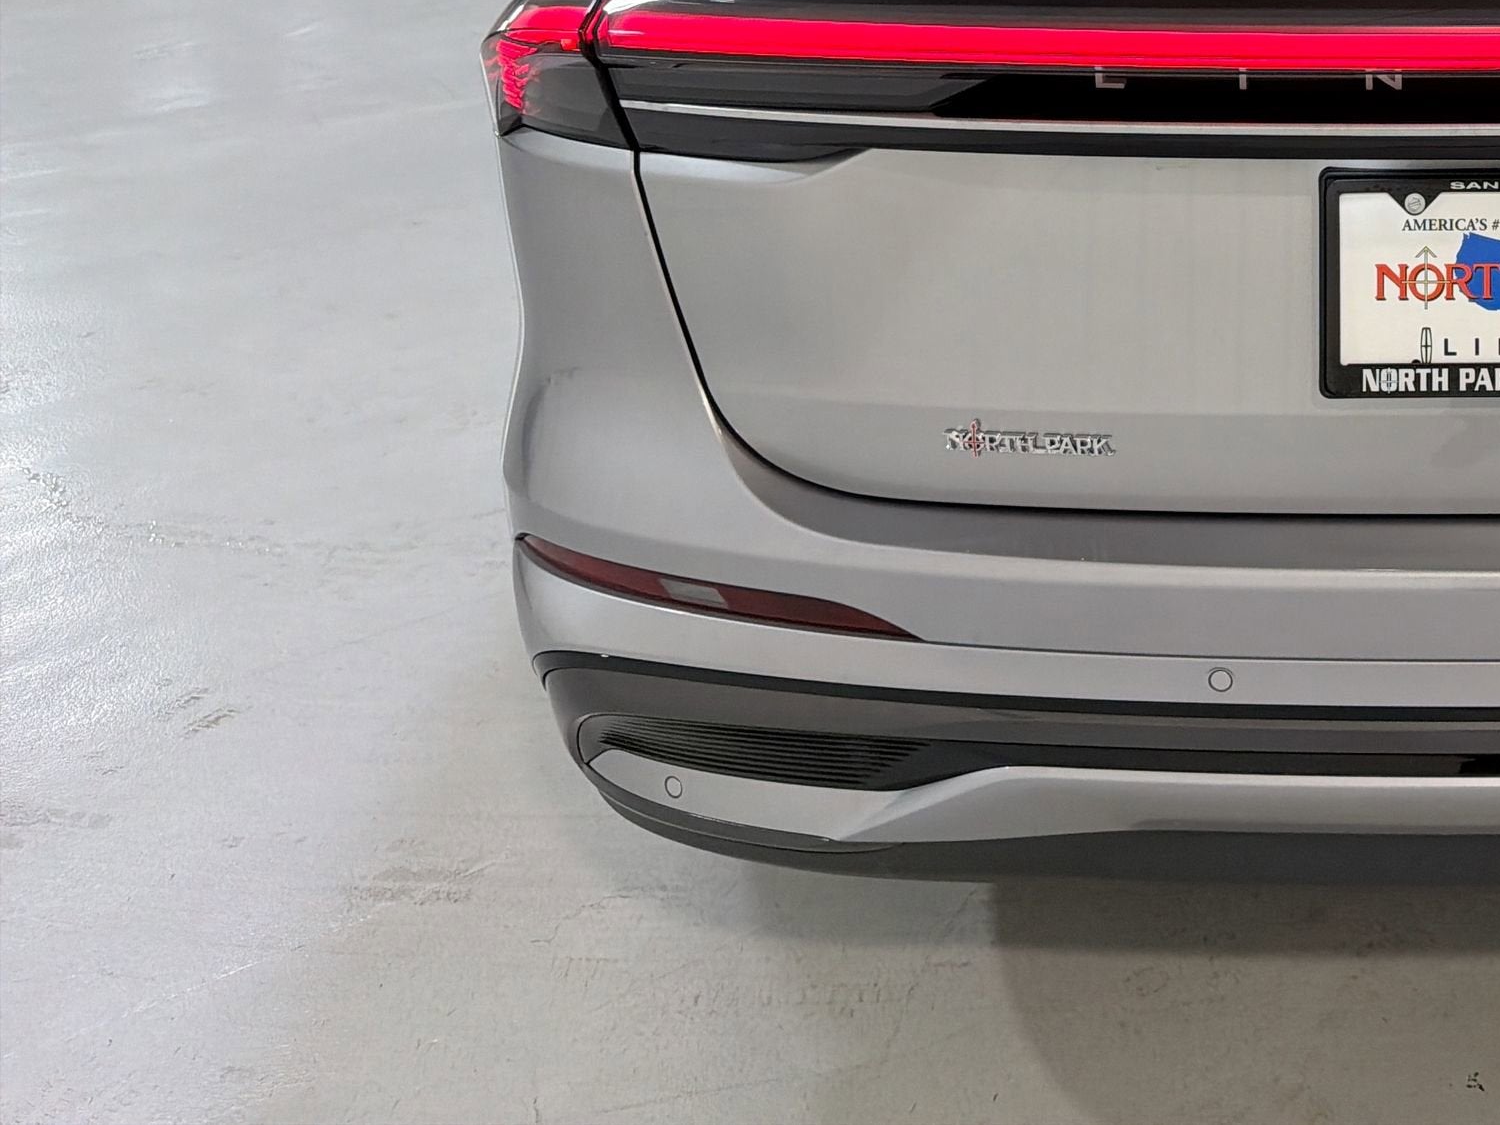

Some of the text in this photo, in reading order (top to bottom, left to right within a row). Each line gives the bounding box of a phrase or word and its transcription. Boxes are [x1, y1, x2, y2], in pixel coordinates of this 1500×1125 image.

[1450, 181, 1499, 190] SAN
[1402, 218, 1487, 231] AMERICA'S
[1362, 367, 1449, 393] NORTH
[943, 429, 1117, 456] NORTH PARK
